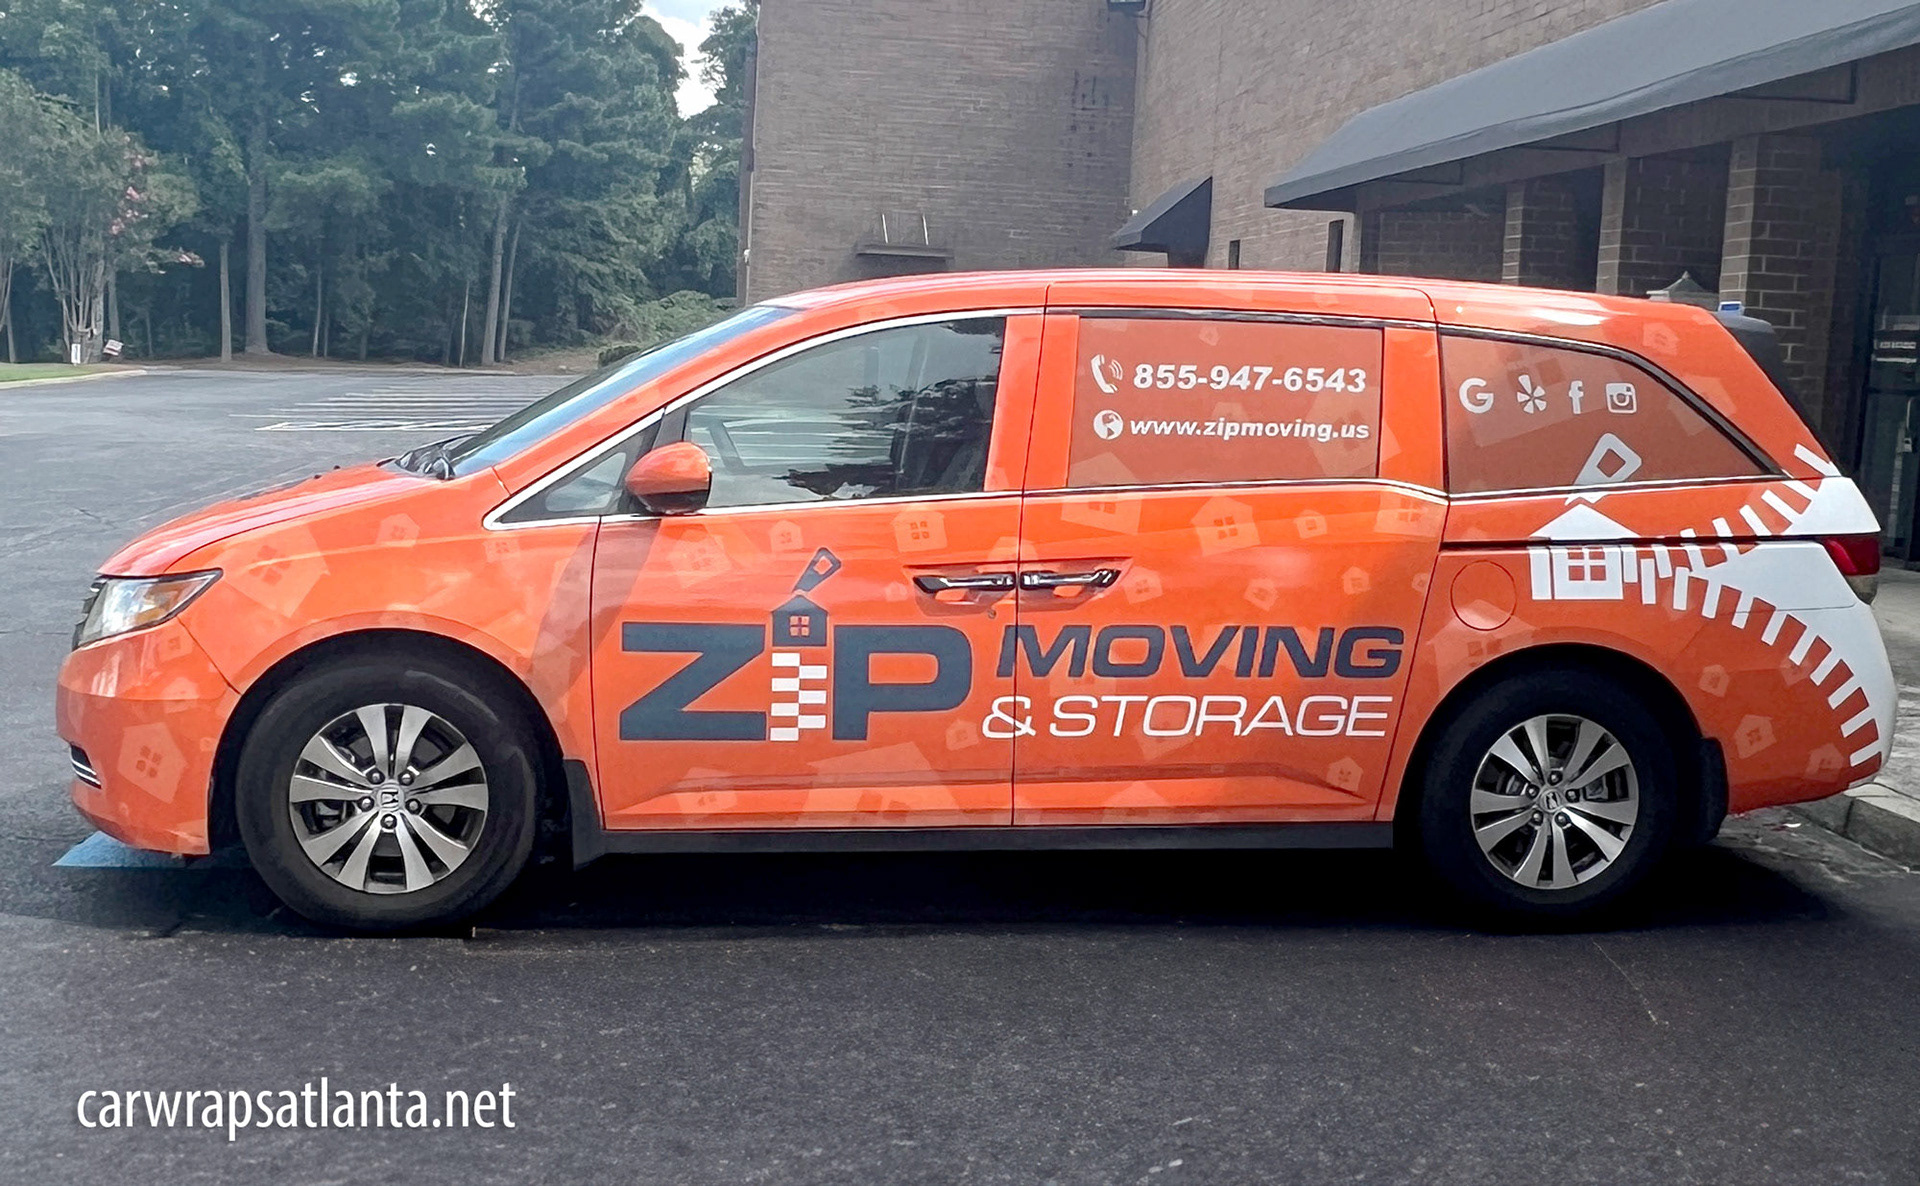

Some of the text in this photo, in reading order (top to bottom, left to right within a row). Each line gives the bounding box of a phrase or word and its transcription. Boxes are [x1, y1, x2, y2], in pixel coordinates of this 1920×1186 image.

[1133, 363, 1367, 393] 855-947-6543
[1458, 377, 1494, 414] G
[1130, 418, 1370, 442] www.zipmoving.us
[996, 624, 1405, 678] MOVING
[982, 695, 1394, 738] & STORAGE
